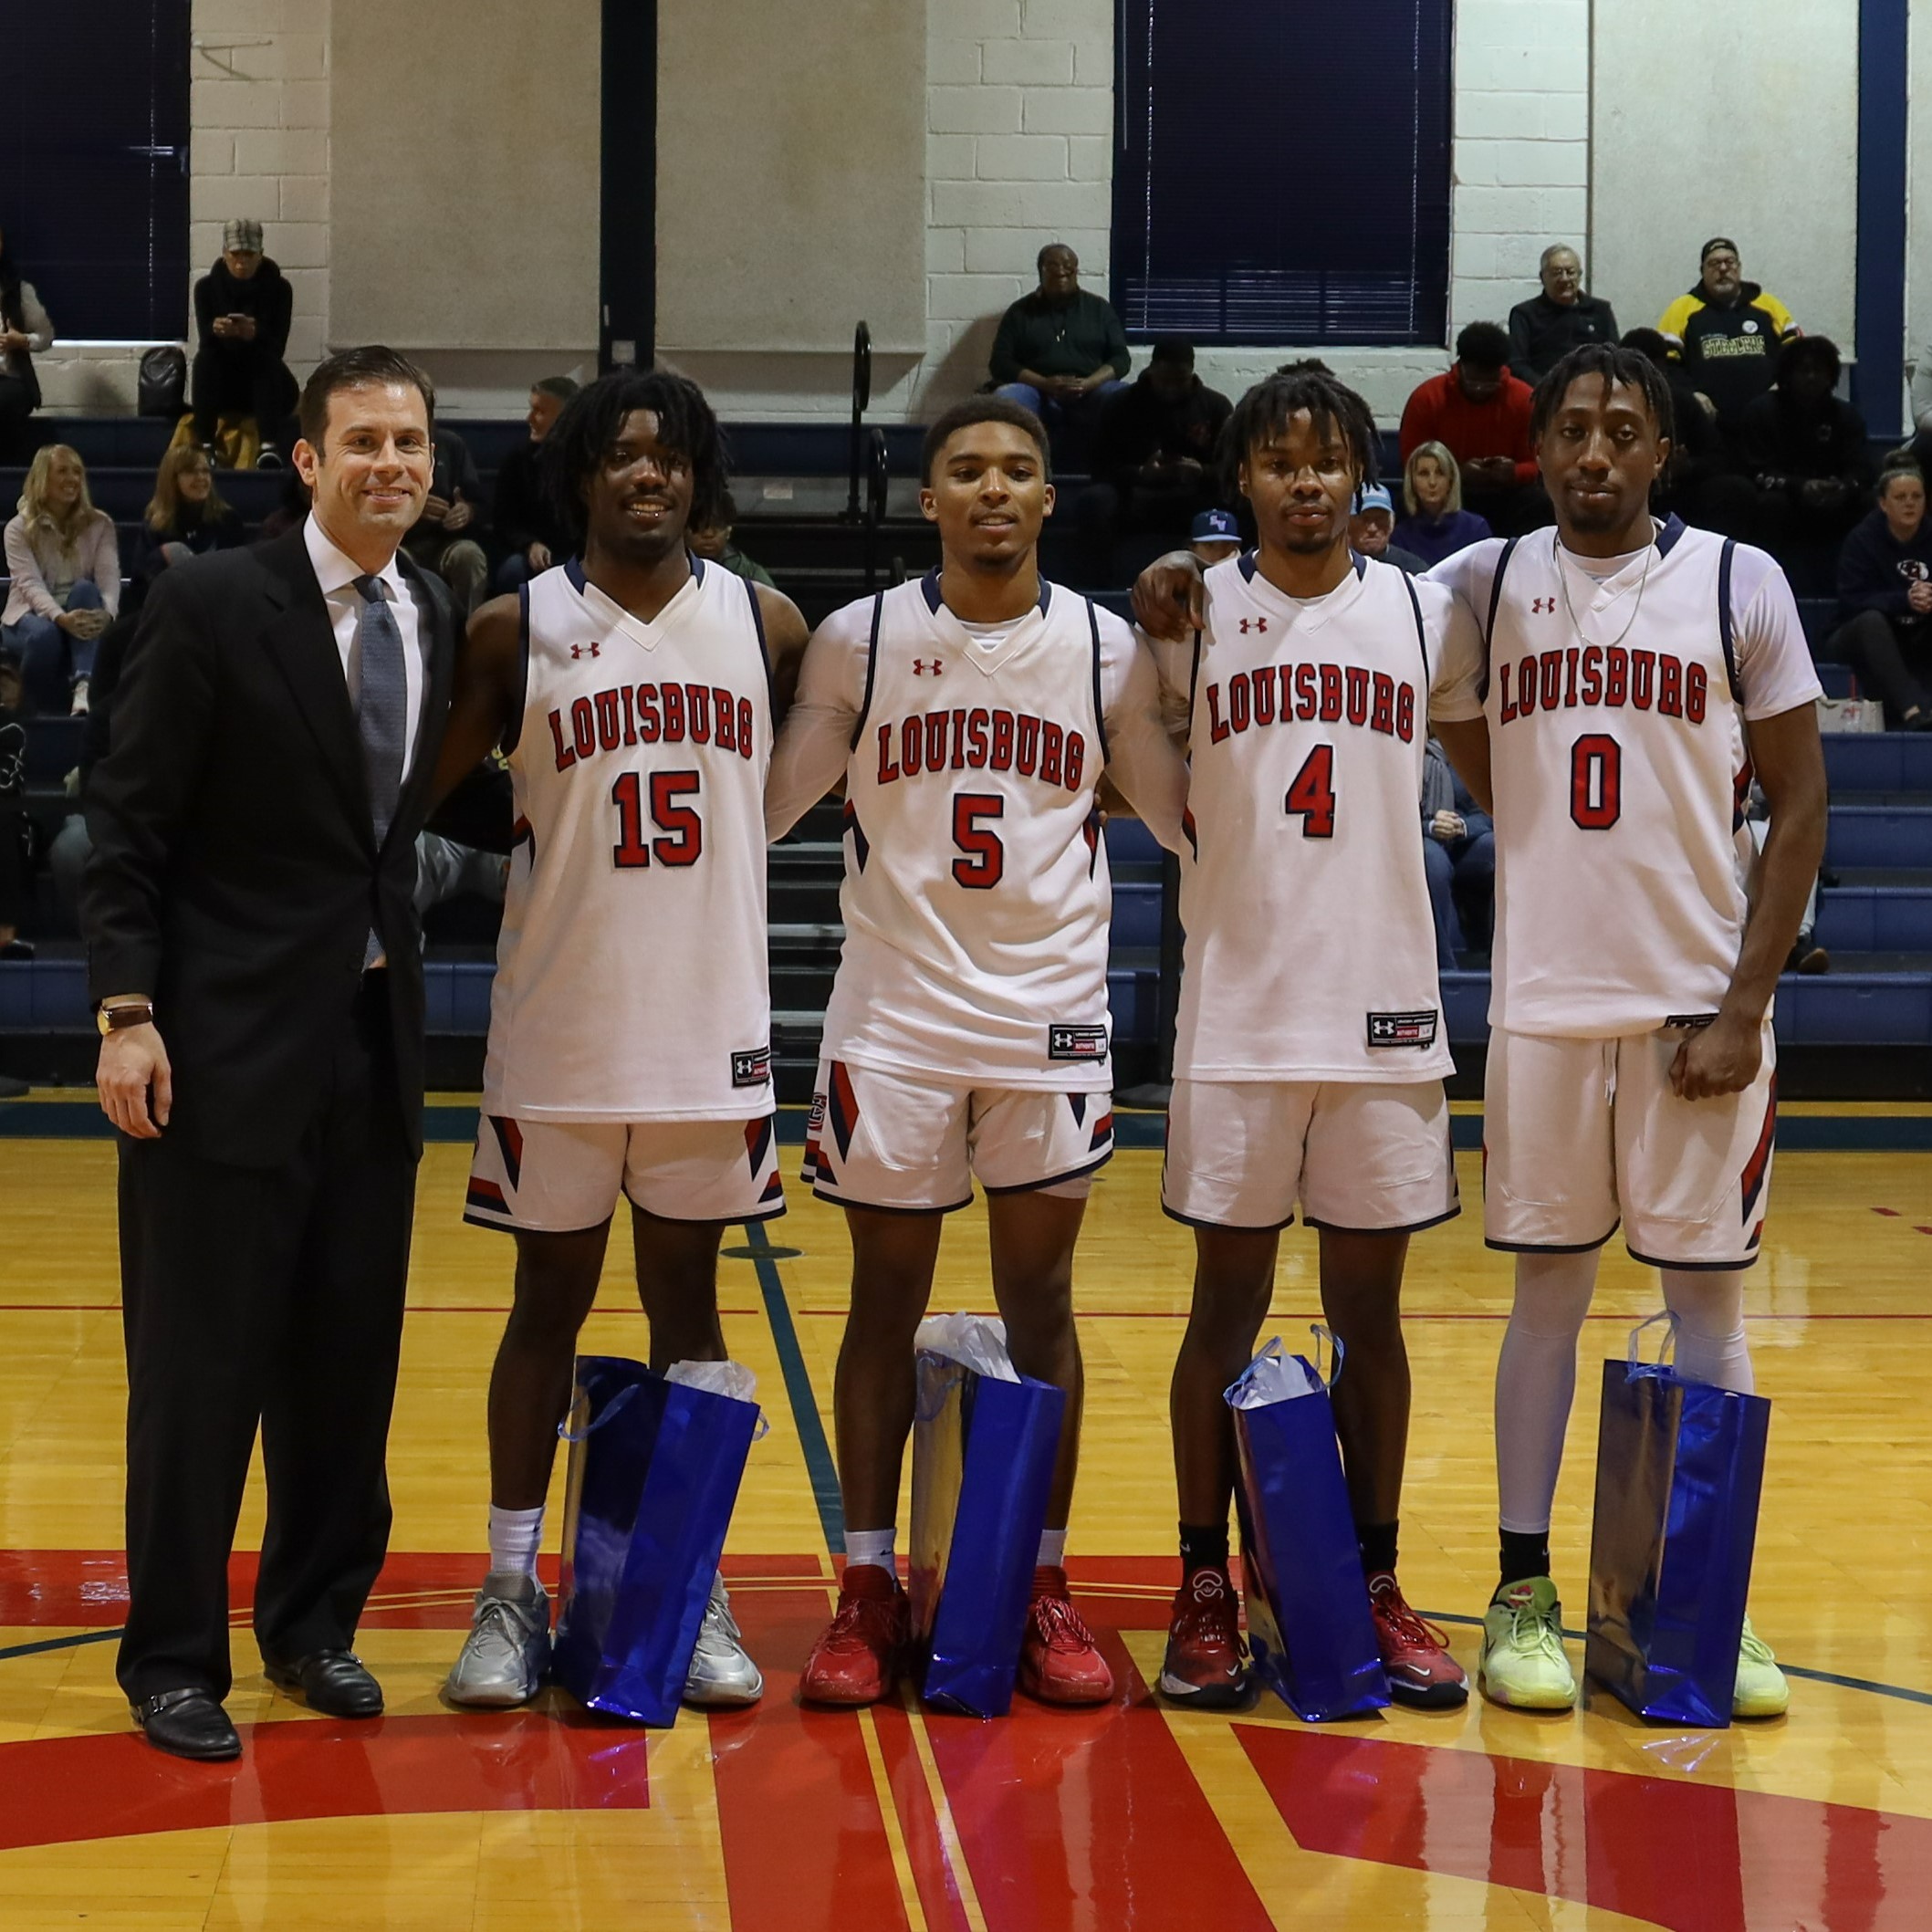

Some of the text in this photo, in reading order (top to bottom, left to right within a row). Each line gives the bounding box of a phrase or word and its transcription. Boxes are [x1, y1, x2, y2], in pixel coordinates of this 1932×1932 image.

[548, 683, 753, 773] LOUISBURG
[1206, 663, 1415, 746] LOUISBURG
[1500, 645, 1707, 726] LOUISBURG
[877, 708, 1085, 792] LOUISBURG
[1285, 744, 1335, 838] 4
[1570, 734, 1621, 830] 0
[611, 770, 702, 868] 15
[952, 793, 1004, 890] 5
